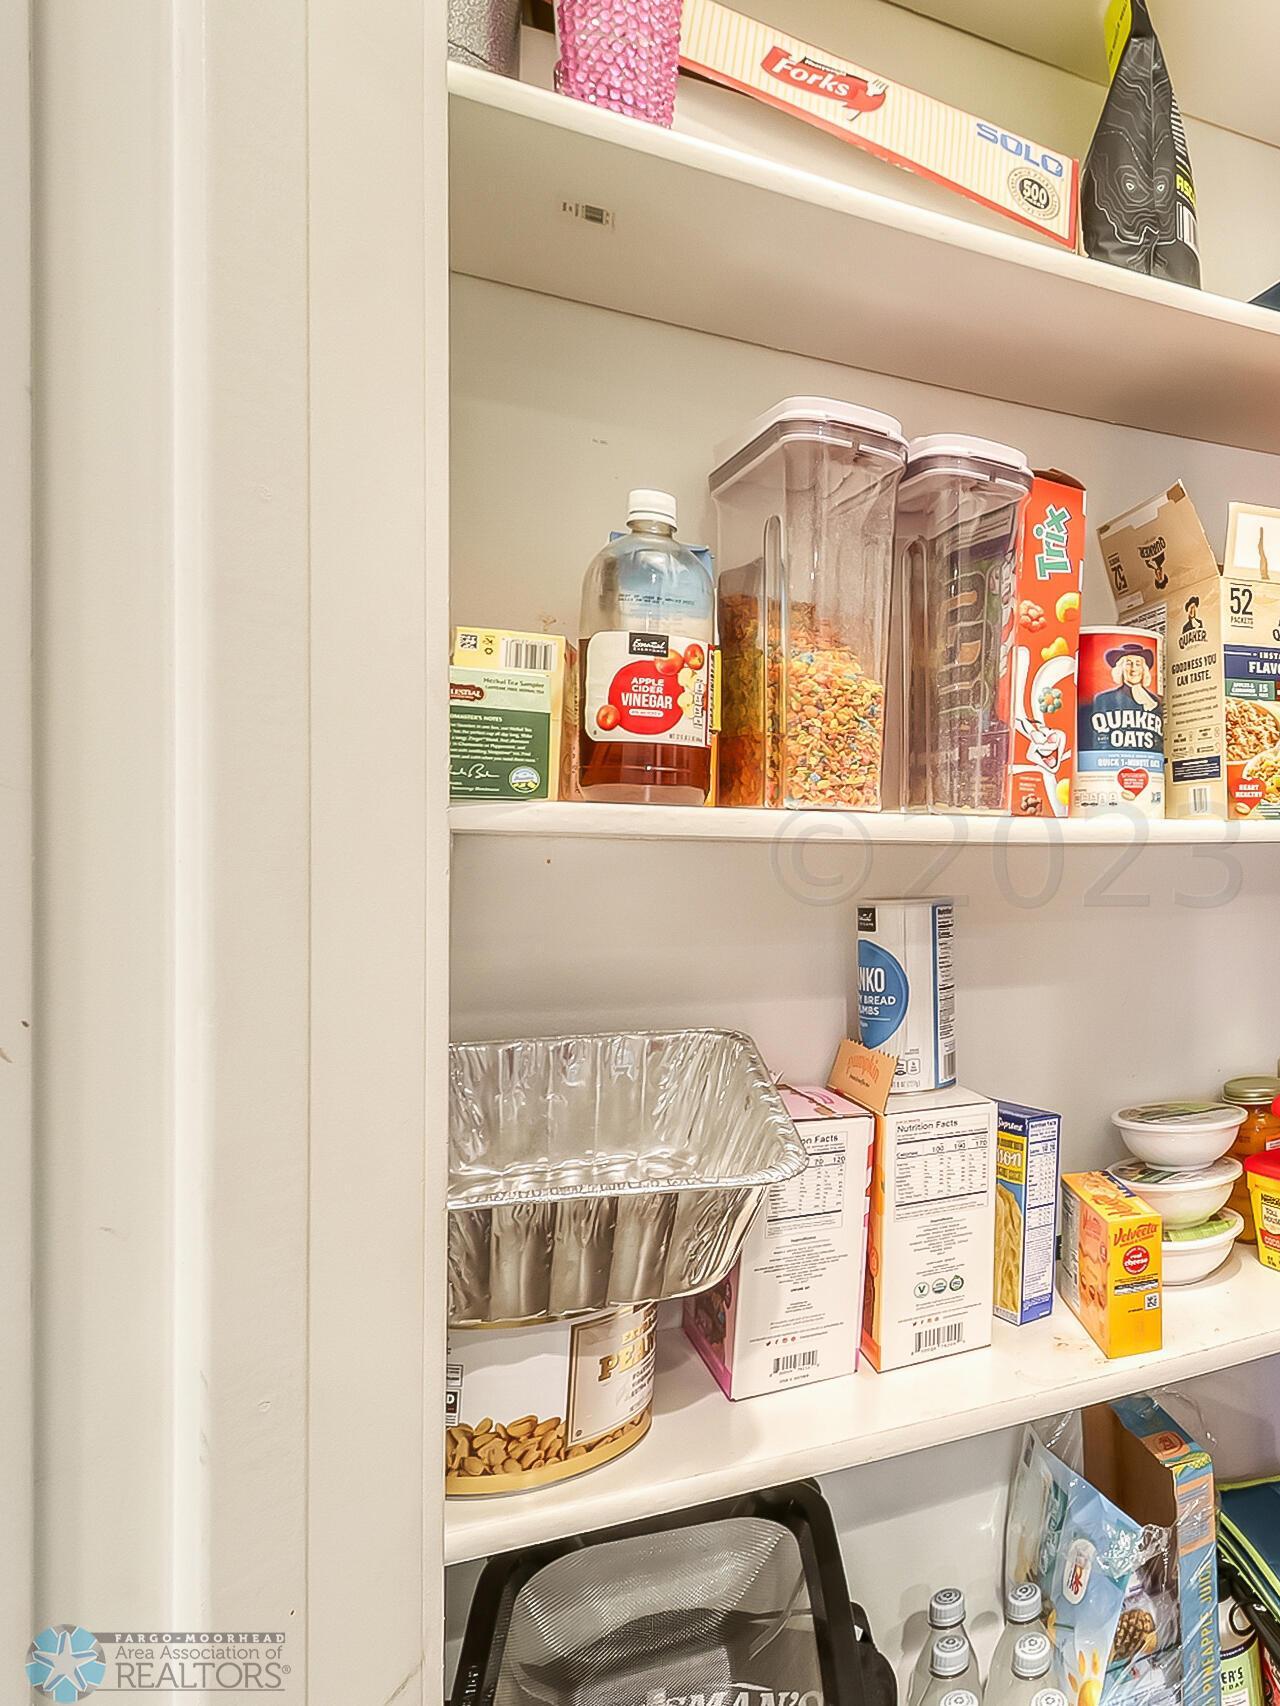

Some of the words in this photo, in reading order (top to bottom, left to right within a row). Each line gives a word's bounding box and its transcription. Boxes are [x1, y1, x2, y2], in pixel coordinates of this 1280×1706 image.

[772, 57, 850, 97] Forks
[976, 122, 1063, 178] SOLO
[1022, 179, 1048, 204] 500
[1036, 504, 1072, 580] Trix
[1230, 587, 1253, 616] 52
[1178, 630, 1209, 650] QUAKER
[1171, 656, 1203, 675] GOODNESS
[1204, 653, 1217, 667] YOU
[630, 676, 665, 687] APPLE
[1176, 674, 1189, 687] CAN
[1190, 670, 1212, 682] TASTE.
[1258, 683, 1269, 693] 15
[450, 688, 482, 698] LESTIAL
[631, 684, 664, 694] CIDER
[621, 692, 673, 710] VINEGAR
[1091, 710, 1164, 737] QUAKER
[1110, 730, 1155, 749] OATS
[857, 967, 885, 993] NKO
[863, 995, 897, 1005] BREAD
[896, 1121, 934, 1133] Nutrition
[935, 1120, 958, 1129] Facts
[814, 1134, 839, 1144] Facts
[1114, 1222, 1158, 1246] Velveeta
[1221, 1667, 1244, 1685] ER'S
